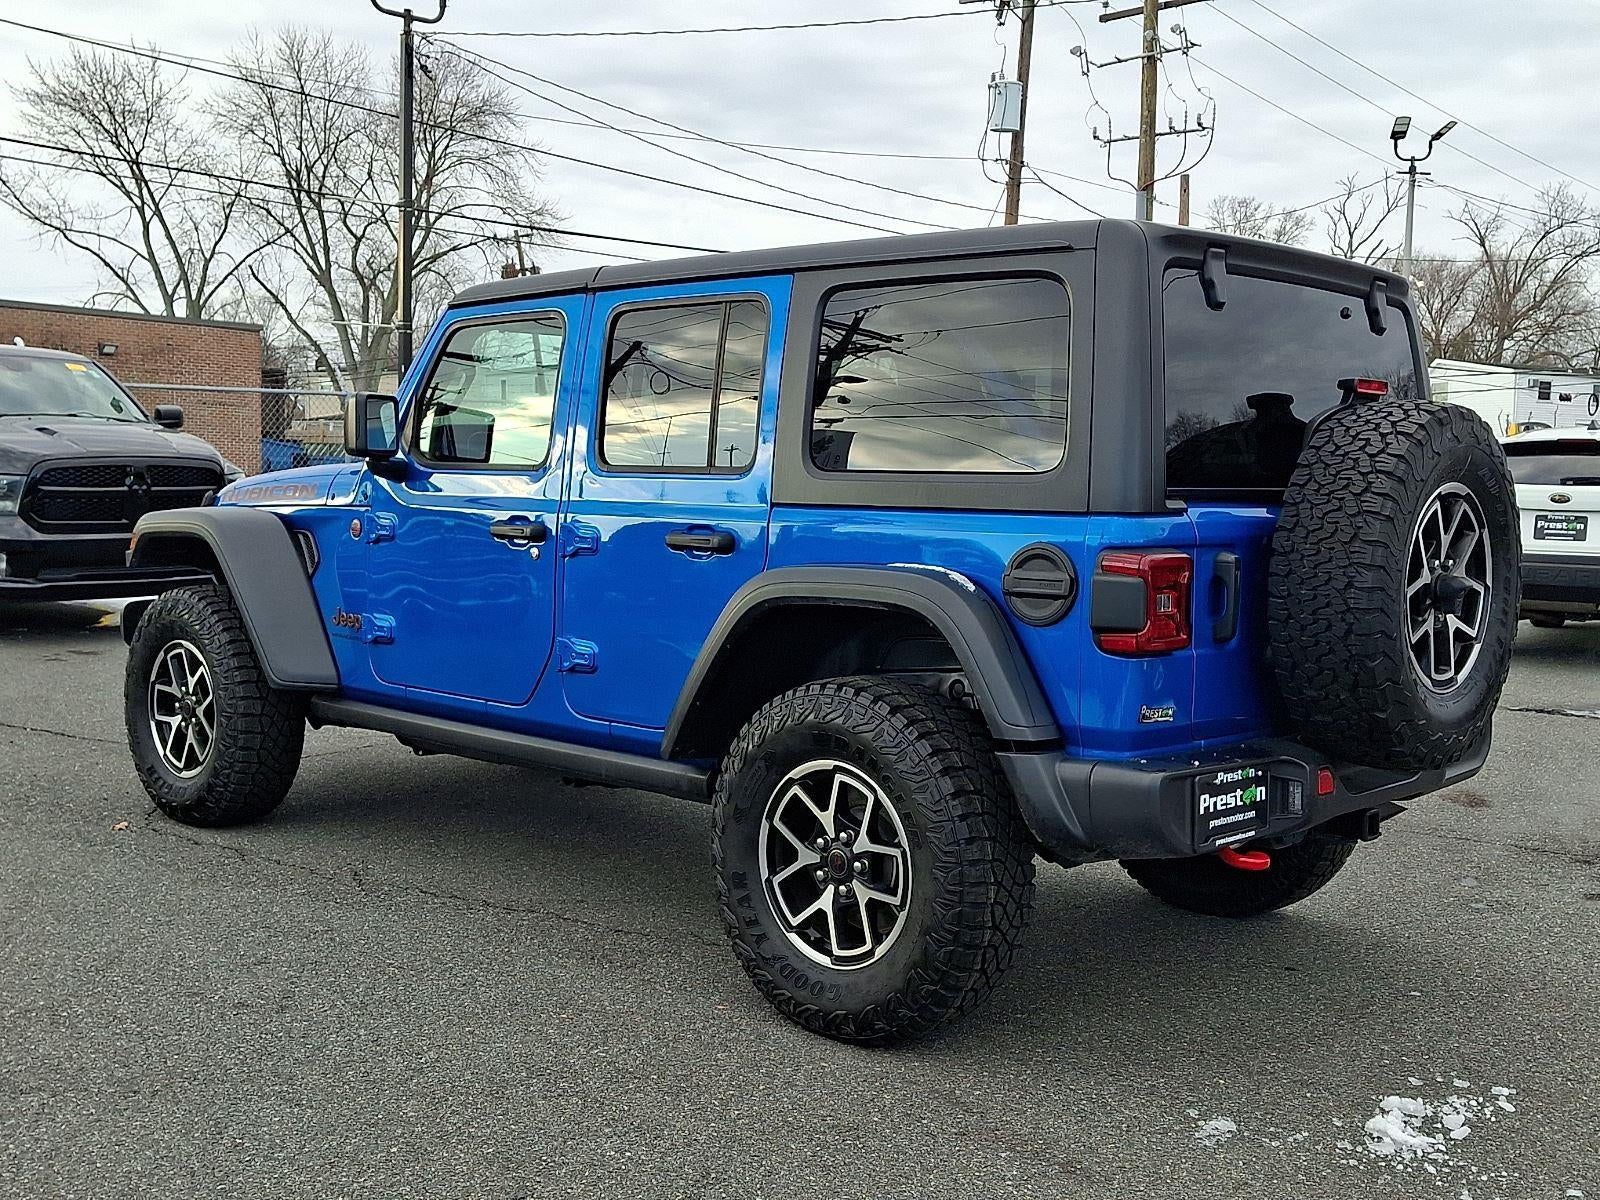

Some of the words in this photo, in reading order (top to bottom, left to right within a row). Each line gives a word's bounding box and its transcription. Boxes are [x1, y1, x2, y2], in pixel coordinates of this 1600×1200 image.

[221, 484, 320, 502] RUBICON
[332, 607, 362, 632] Jeep
[1209, 810, 1256, 830] prestonmotor.com
[731, 870, 842, 1003] GOODYEAR
